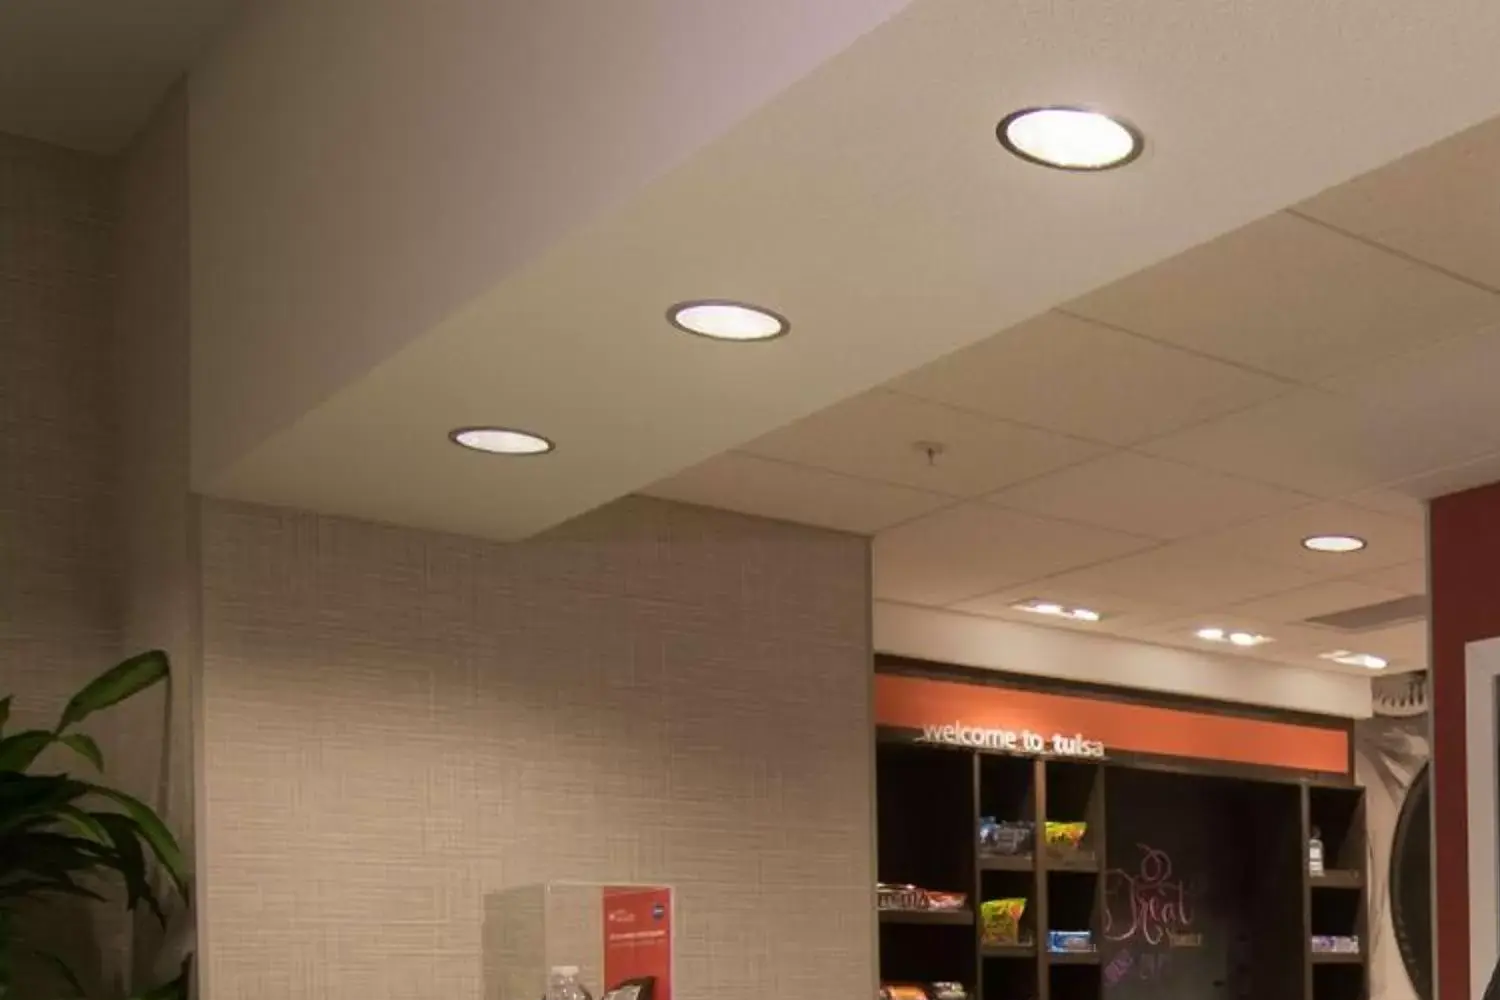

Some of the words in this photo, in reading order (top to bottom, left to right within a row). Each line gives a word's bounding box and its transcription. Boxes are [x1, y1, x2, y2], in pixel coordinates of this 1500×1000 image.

[923, 720, 1016, 748] welcome
[1023, 729, 1044, 751] to
[1052, 732, 1105, 757] tulsa
